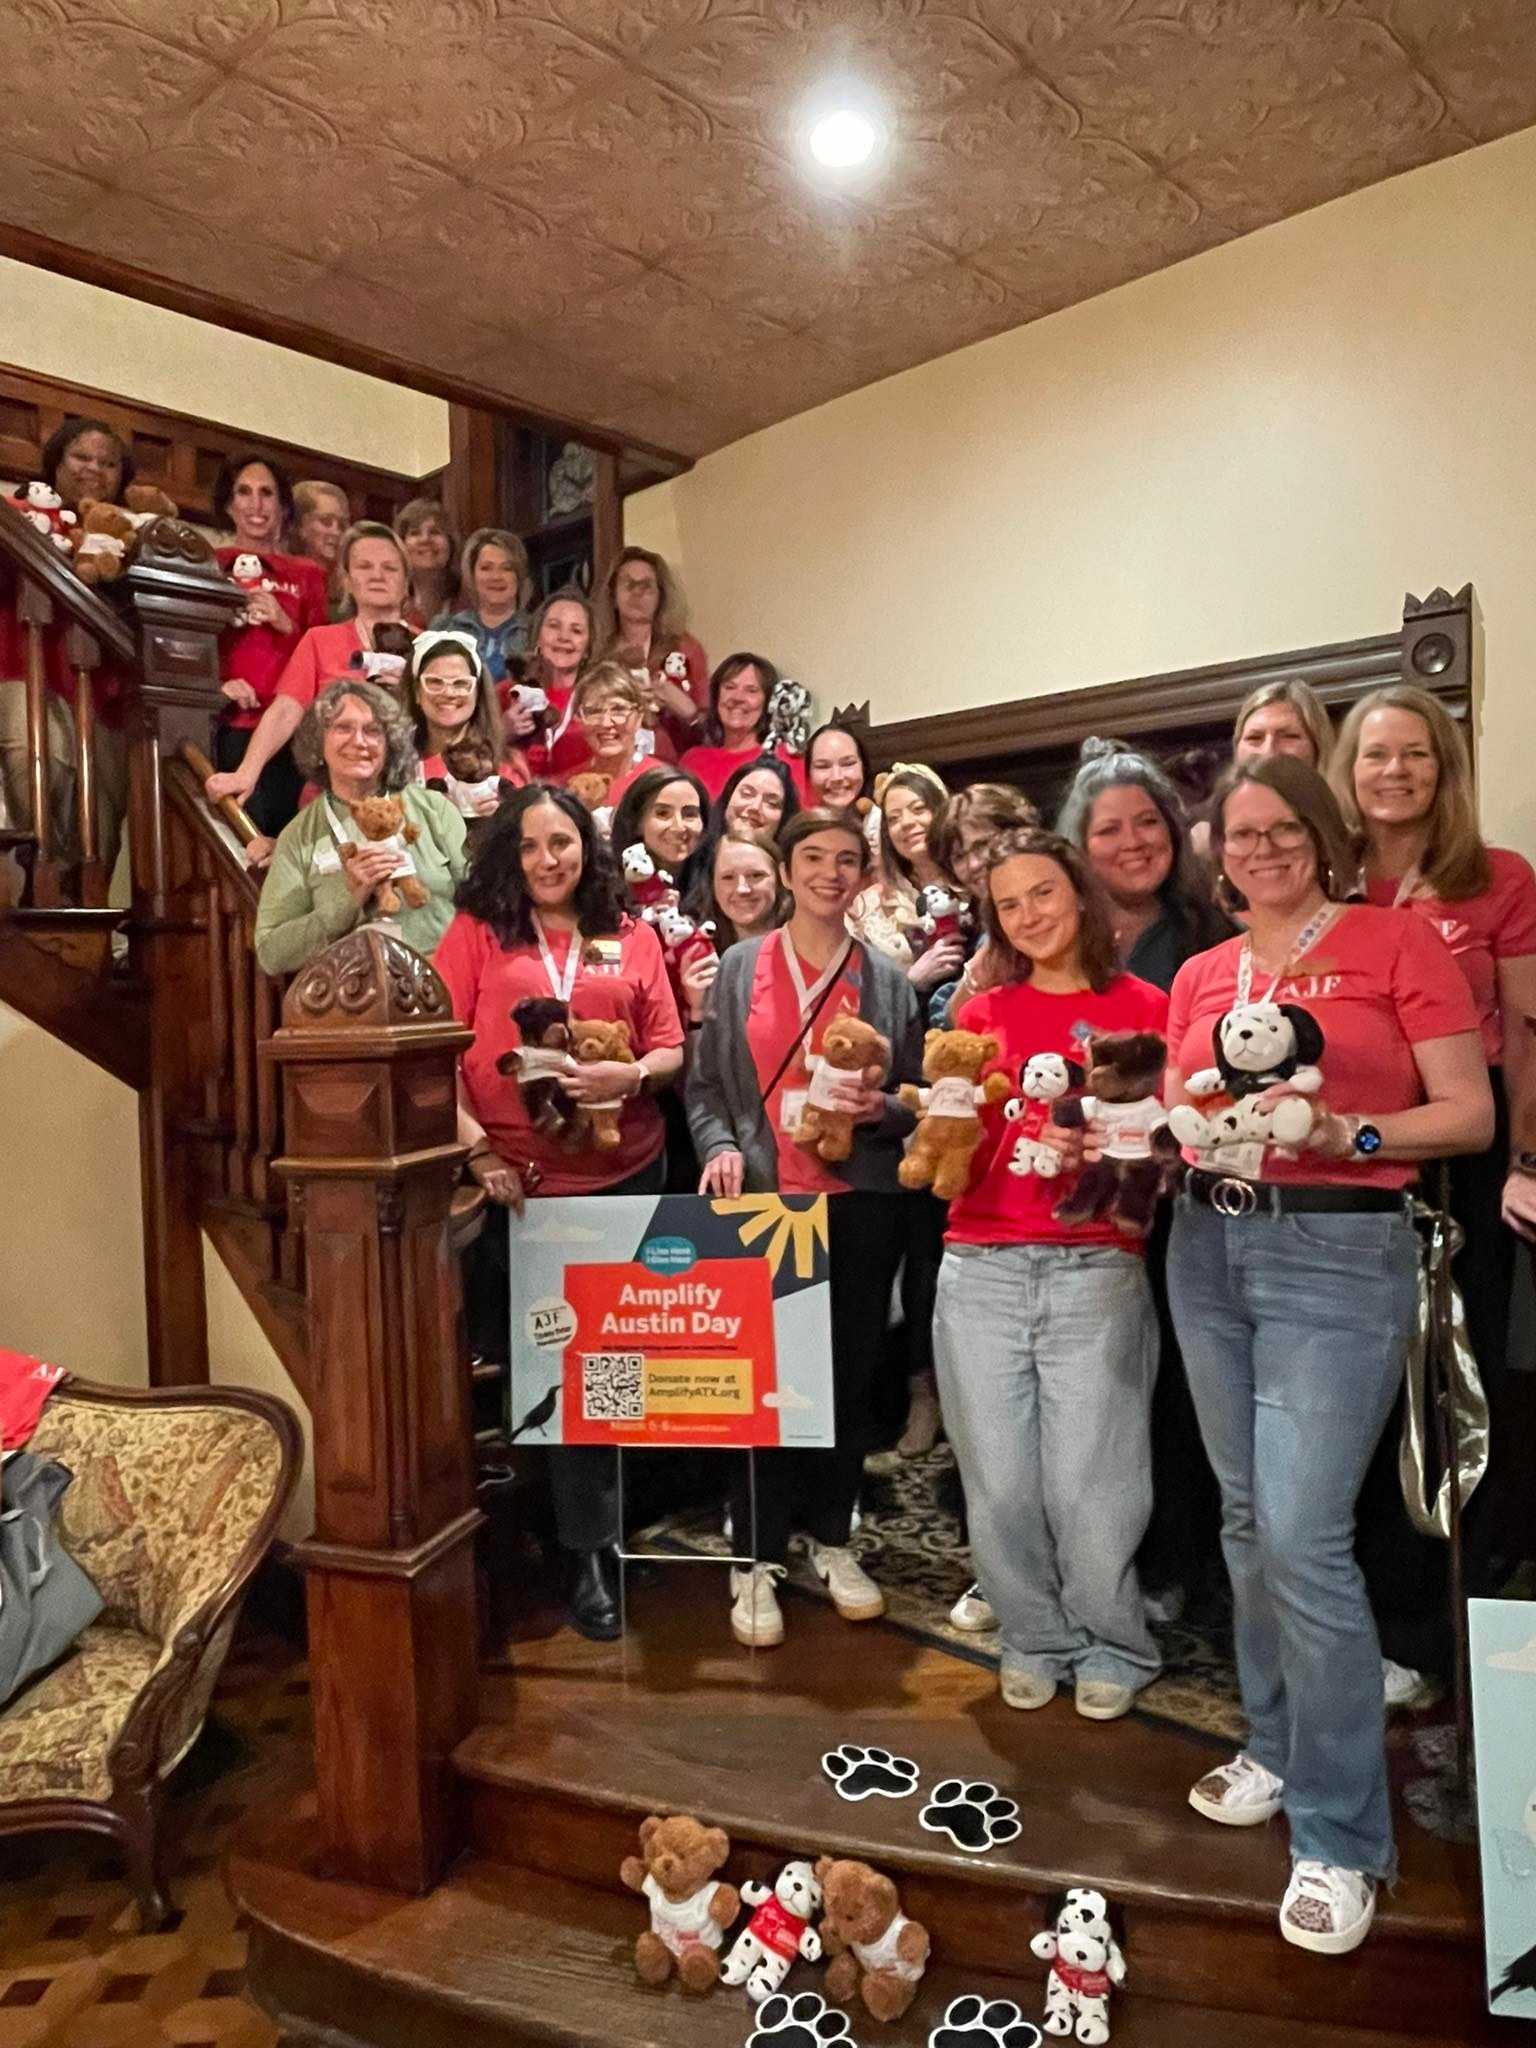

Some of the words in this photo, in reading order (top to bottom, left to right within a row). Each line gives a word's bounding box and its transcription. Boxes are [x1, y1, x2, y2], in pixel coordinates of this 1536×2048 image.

[619, 1283, 722, 1310] Amplify
[601, 1312, 686, 1334] Austin
[691, 1311, 742, 1339] Day
[648, 1374, 691, 1383] Donate
[724, 1375, 737, 1383] at
[648, 1387, 740, 1400] AmplifyATX.org
